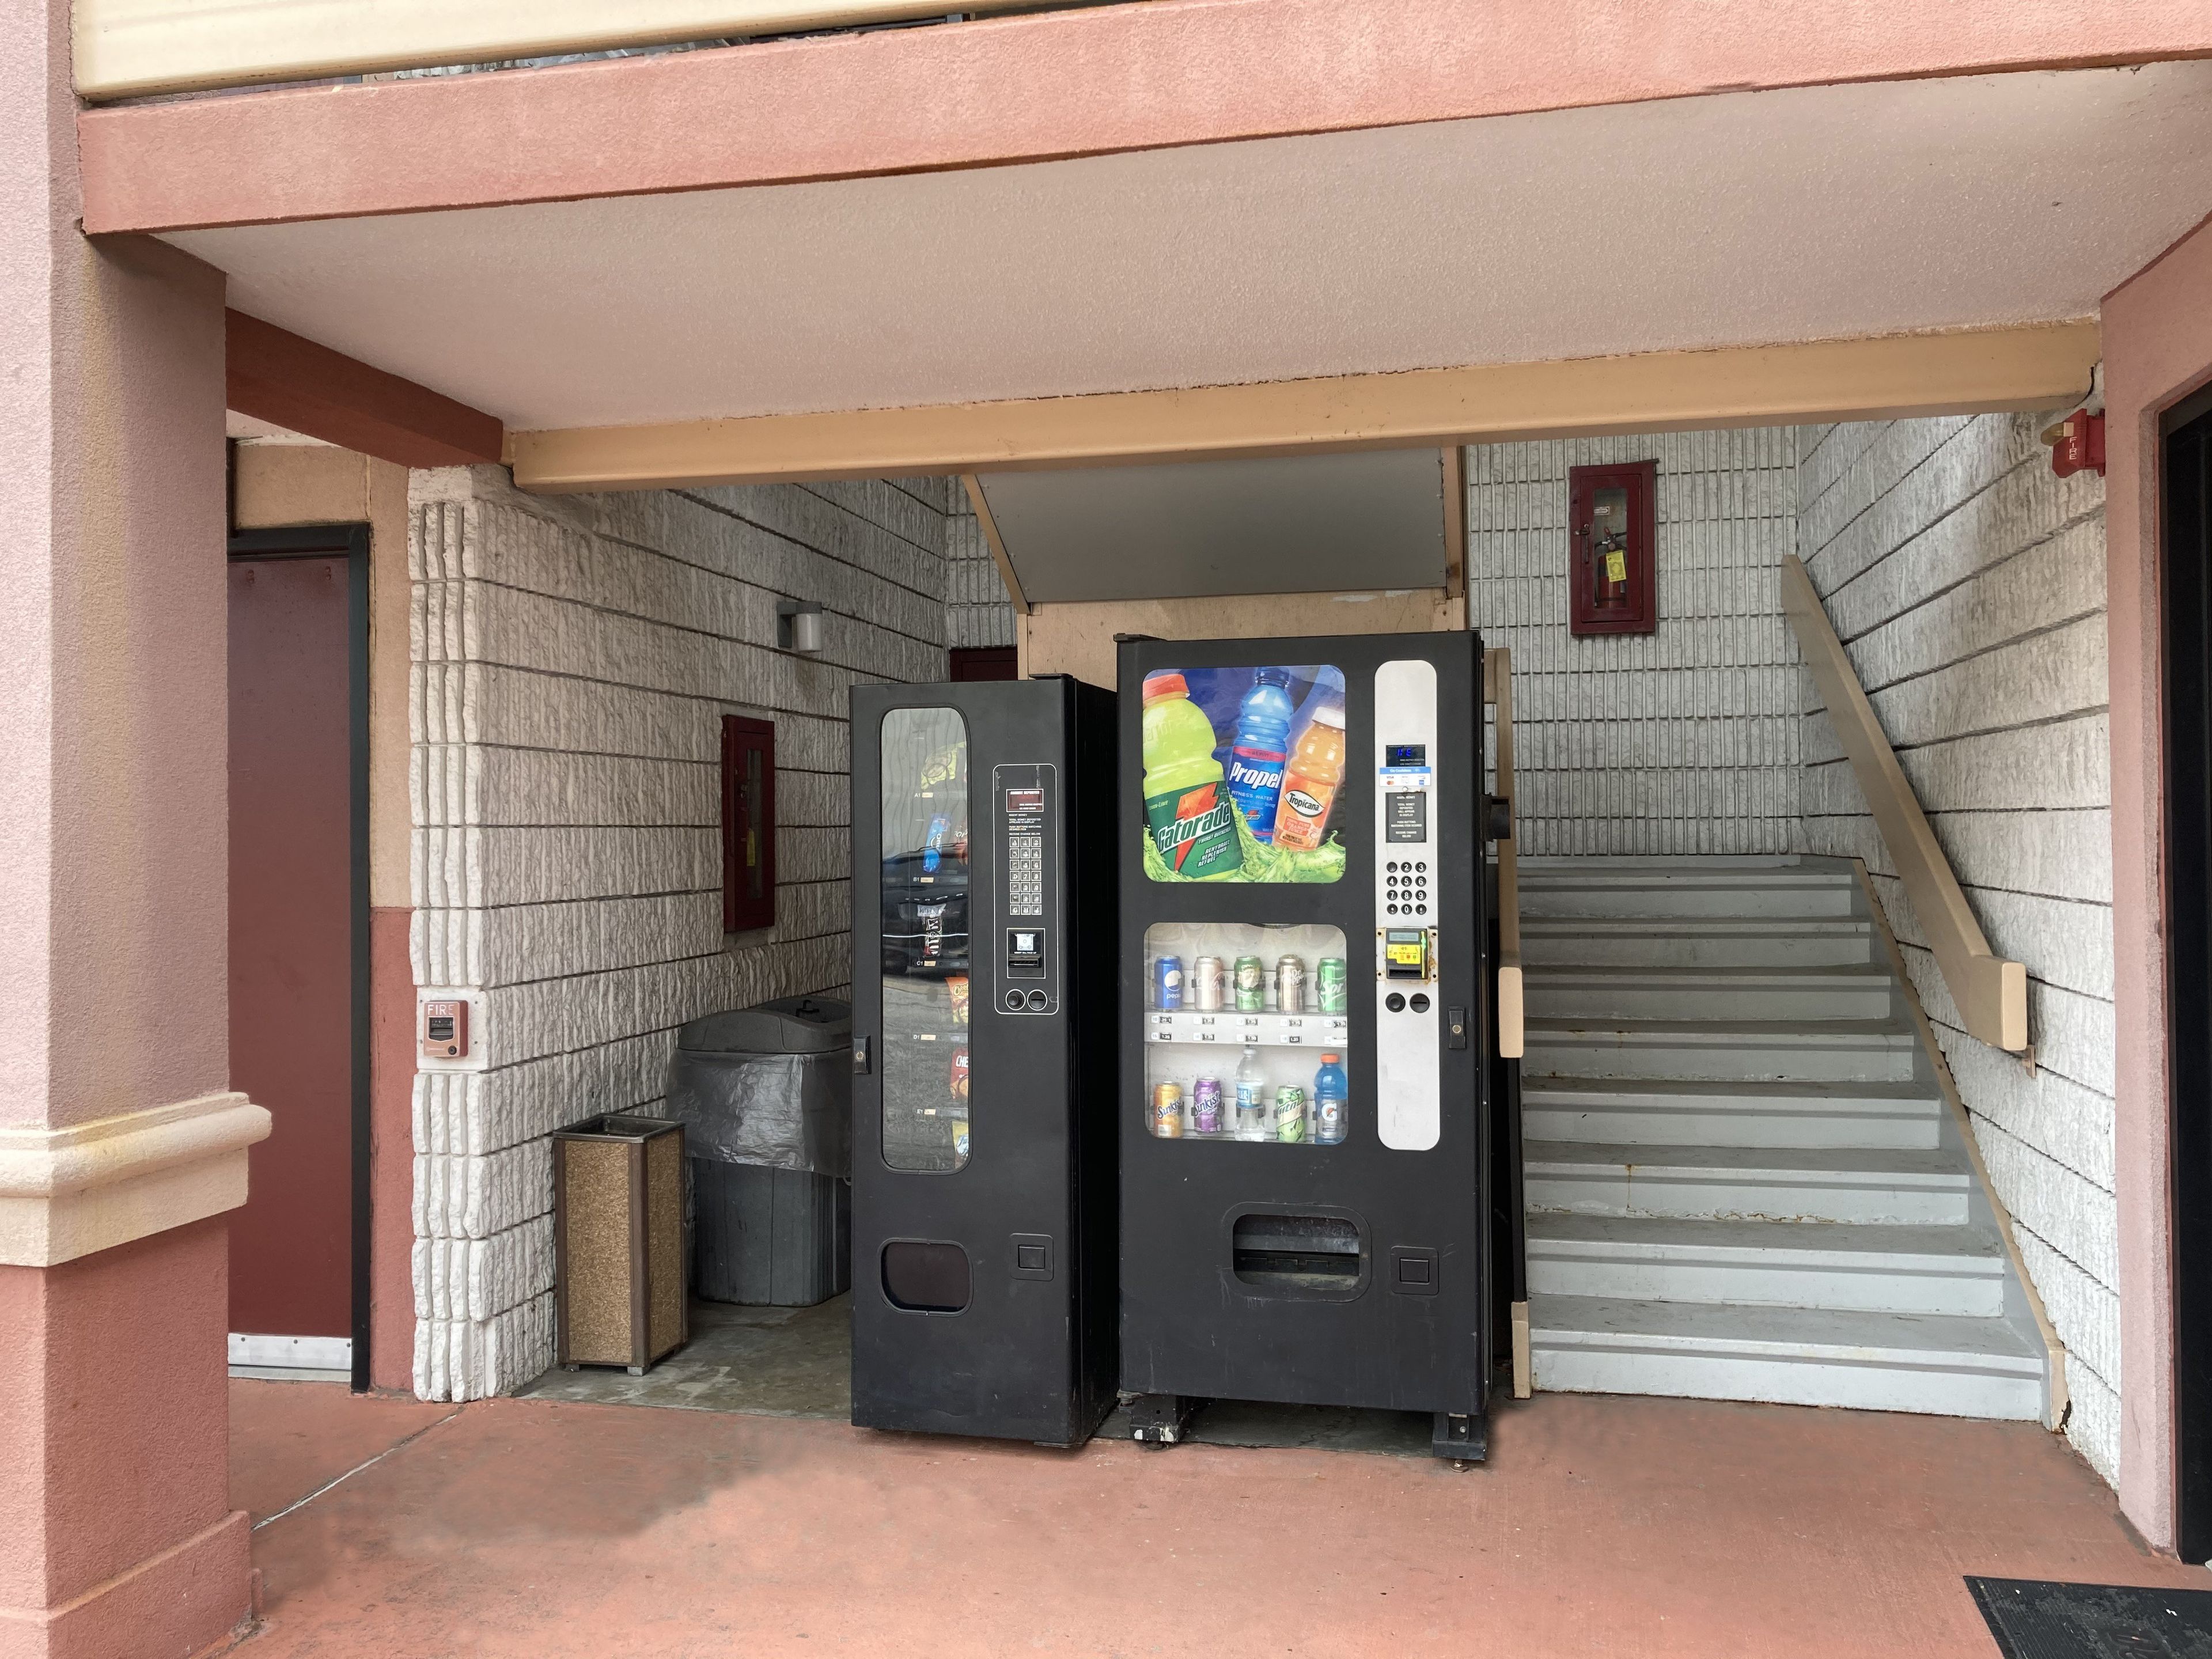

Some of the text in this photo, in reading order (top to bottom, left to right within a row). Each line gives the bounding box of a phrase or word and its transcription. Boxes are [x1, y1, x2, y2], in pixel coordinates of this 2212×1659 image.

[2069, 437, 2077, 460] FIRE
[1229, 762, 1283, 790] Propel
[1289, 793, 1320, 811] Tropicana
[1158, 801, 1231, 854] Gatorade
[1198, 857, 1216, 867] REFUEL
[1202, 846, 1227, 861] REPLENISH
[427, 1004, 454, 1016] FIRE
[956, 1055, 968, 1067] CHE
[1157, 1098, 1180, 1120] Sunkis
[1194, 1090, 1220, 1118] Sunkist
